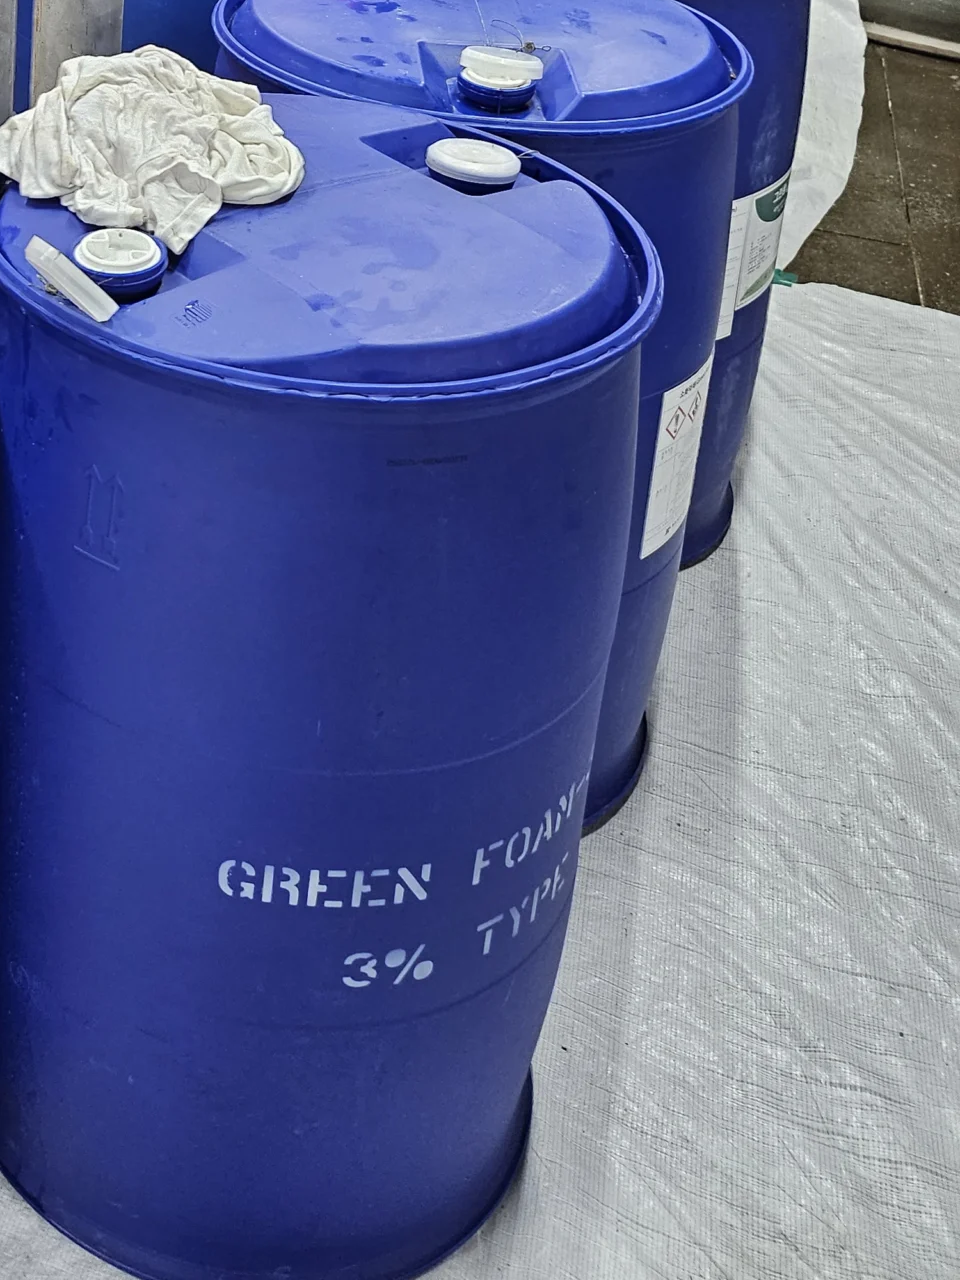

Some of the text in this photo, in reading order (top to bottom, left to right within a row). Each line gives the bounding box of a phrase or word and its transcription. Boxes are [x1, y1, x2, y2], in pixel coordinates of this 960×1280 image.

[217, 859, 432, 908] GREEN
[342, 851, 569, 988] 3% TYPE
